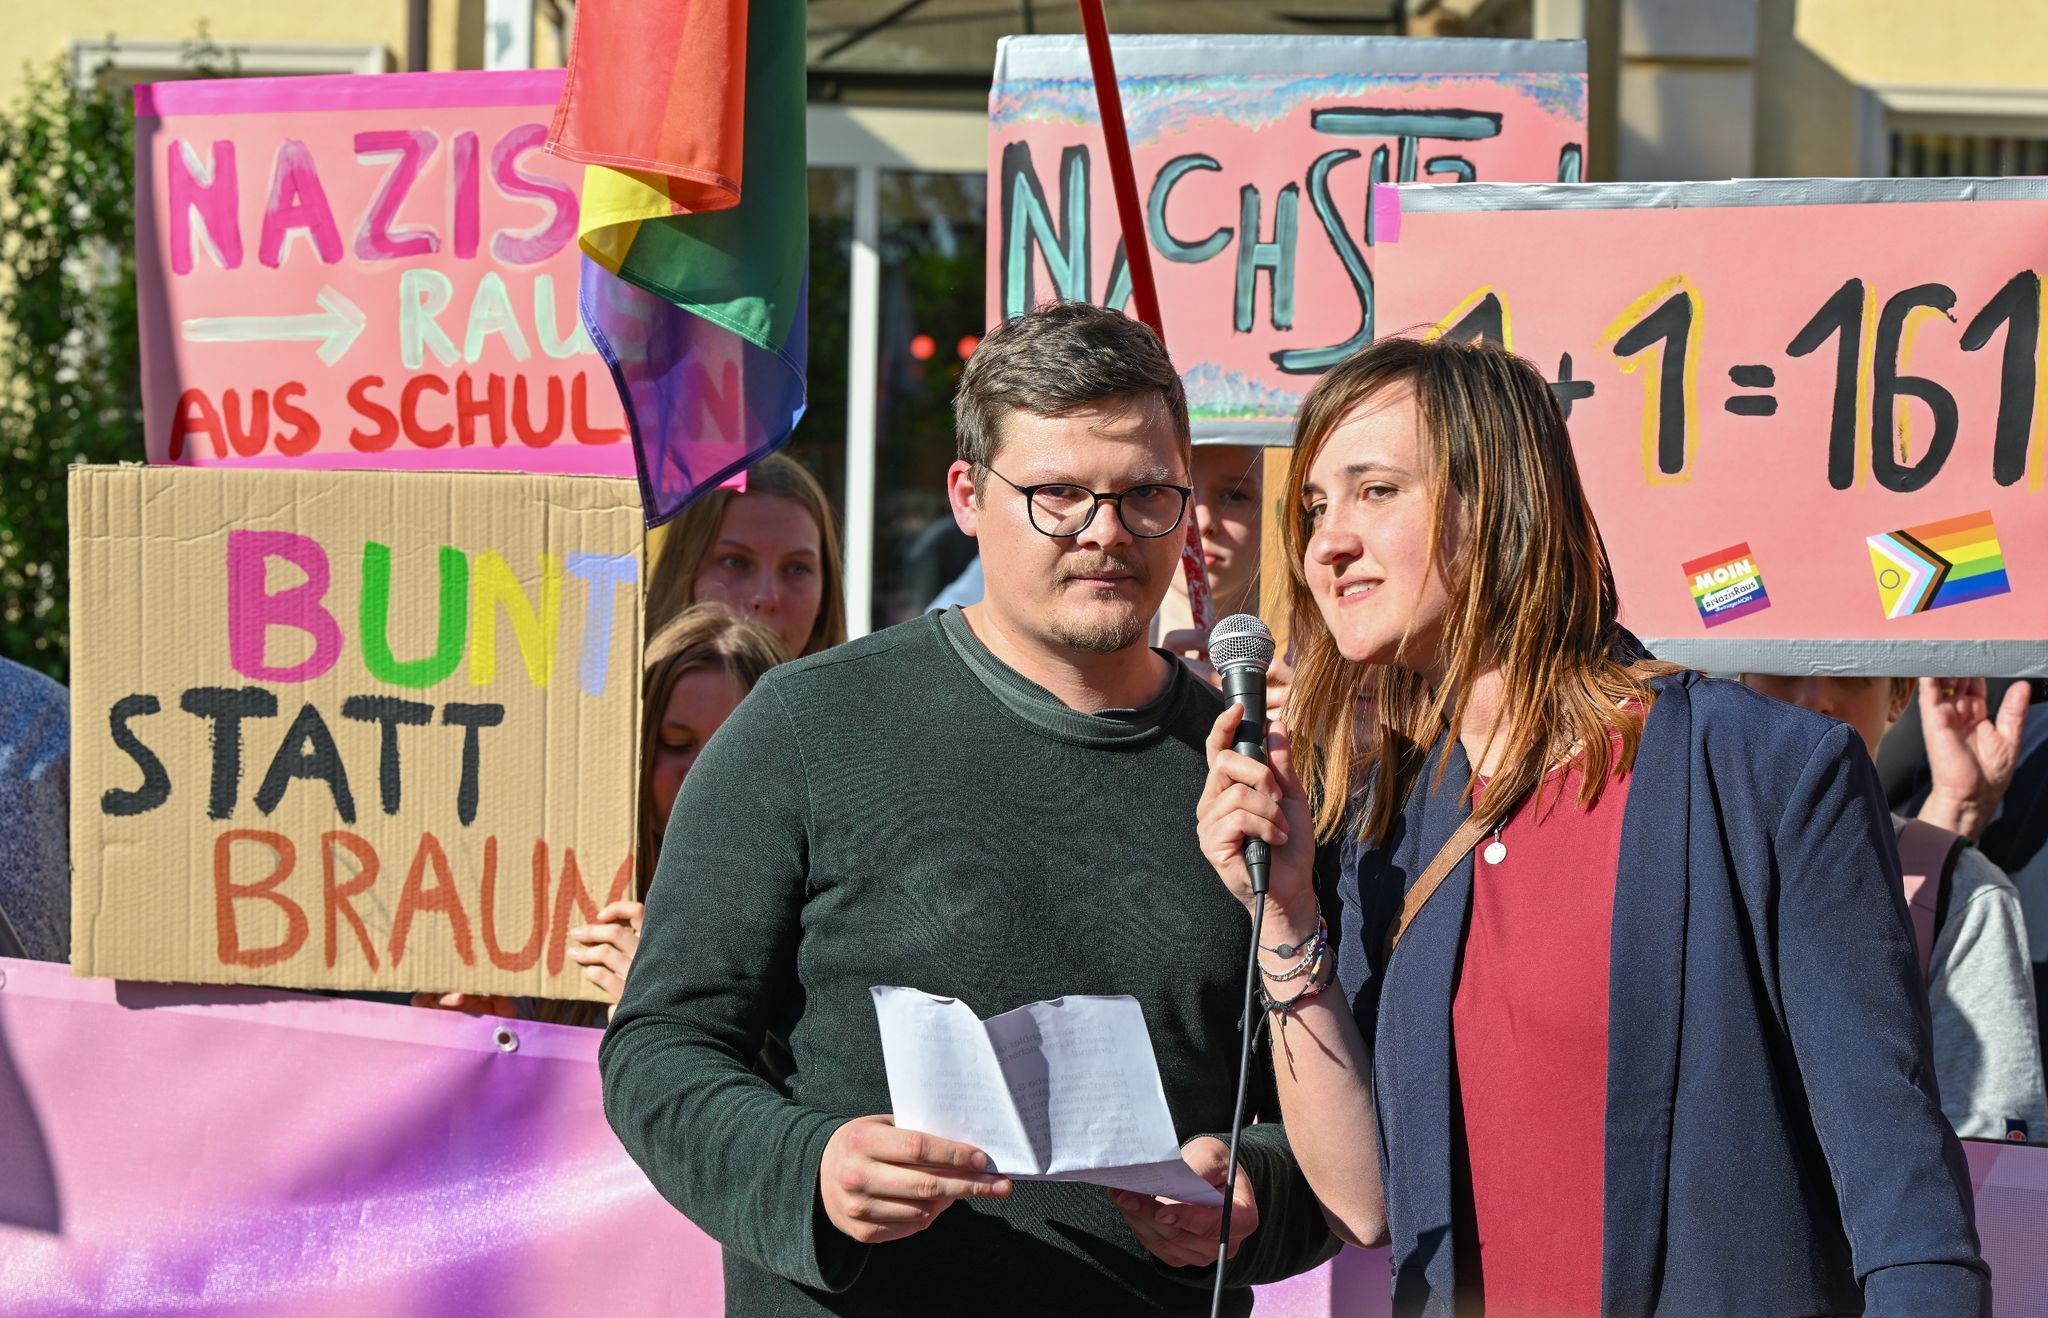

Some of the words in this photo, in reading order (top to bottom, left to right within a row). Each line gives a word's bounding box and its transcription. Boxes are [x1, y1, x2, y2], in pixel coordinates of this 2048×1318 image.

[169, 123, 581, 274] NAZIS
[168, 381, 321, 461] AUS
[1604, 281, 1700, 482] 1
[1786, 269, 2041, 492] 161
[226, 528, 638, 697] BUNT
[1695, 559, 1753, 591] MOIN
[1704, 581, 1757, 609] #NazisRaus
[101, 686, 505, 826] STATT
[213, 829, 634, 976] BRAUN
